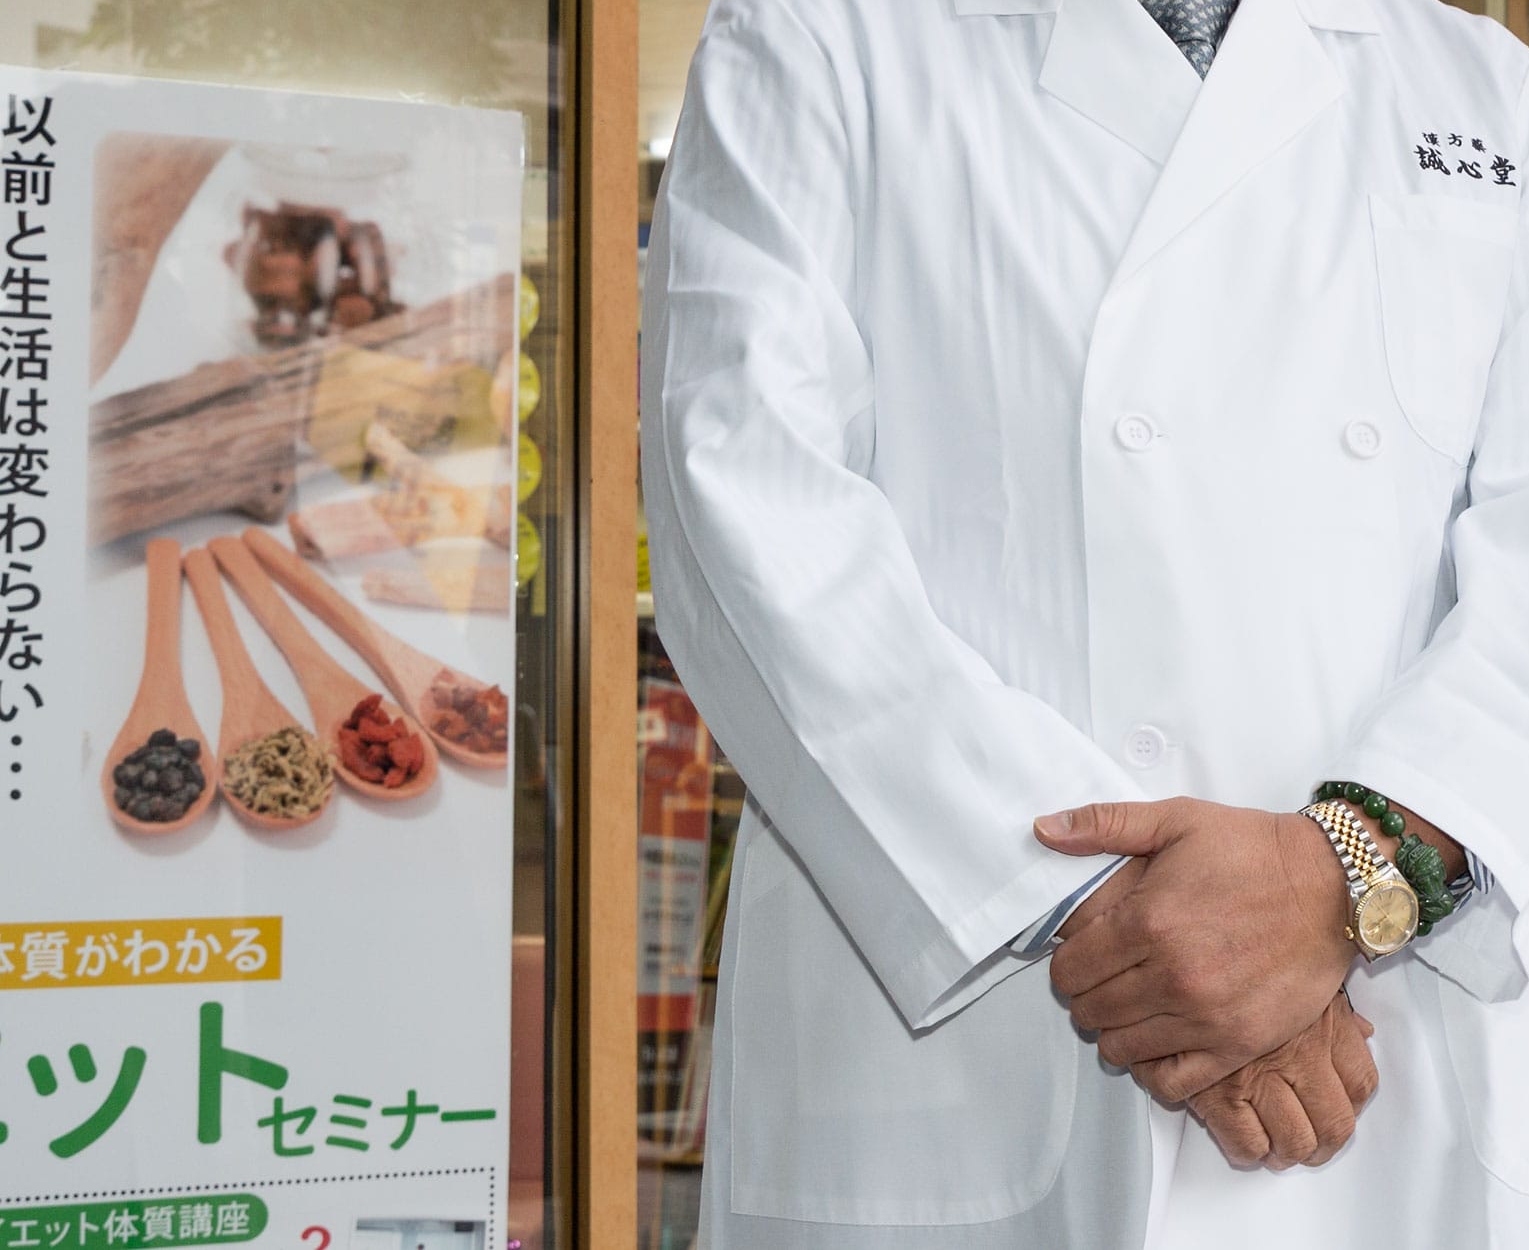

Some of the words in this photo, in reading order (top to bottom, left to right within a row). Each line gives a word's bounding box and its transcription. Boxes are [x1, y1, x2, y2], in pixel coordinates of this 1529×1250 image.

[1421, 131, 1487, 154] 漢方薬
[1413, 144, 1517, 187] 誠心堂
[0, 1201, 252, 1246] エット体質講座
